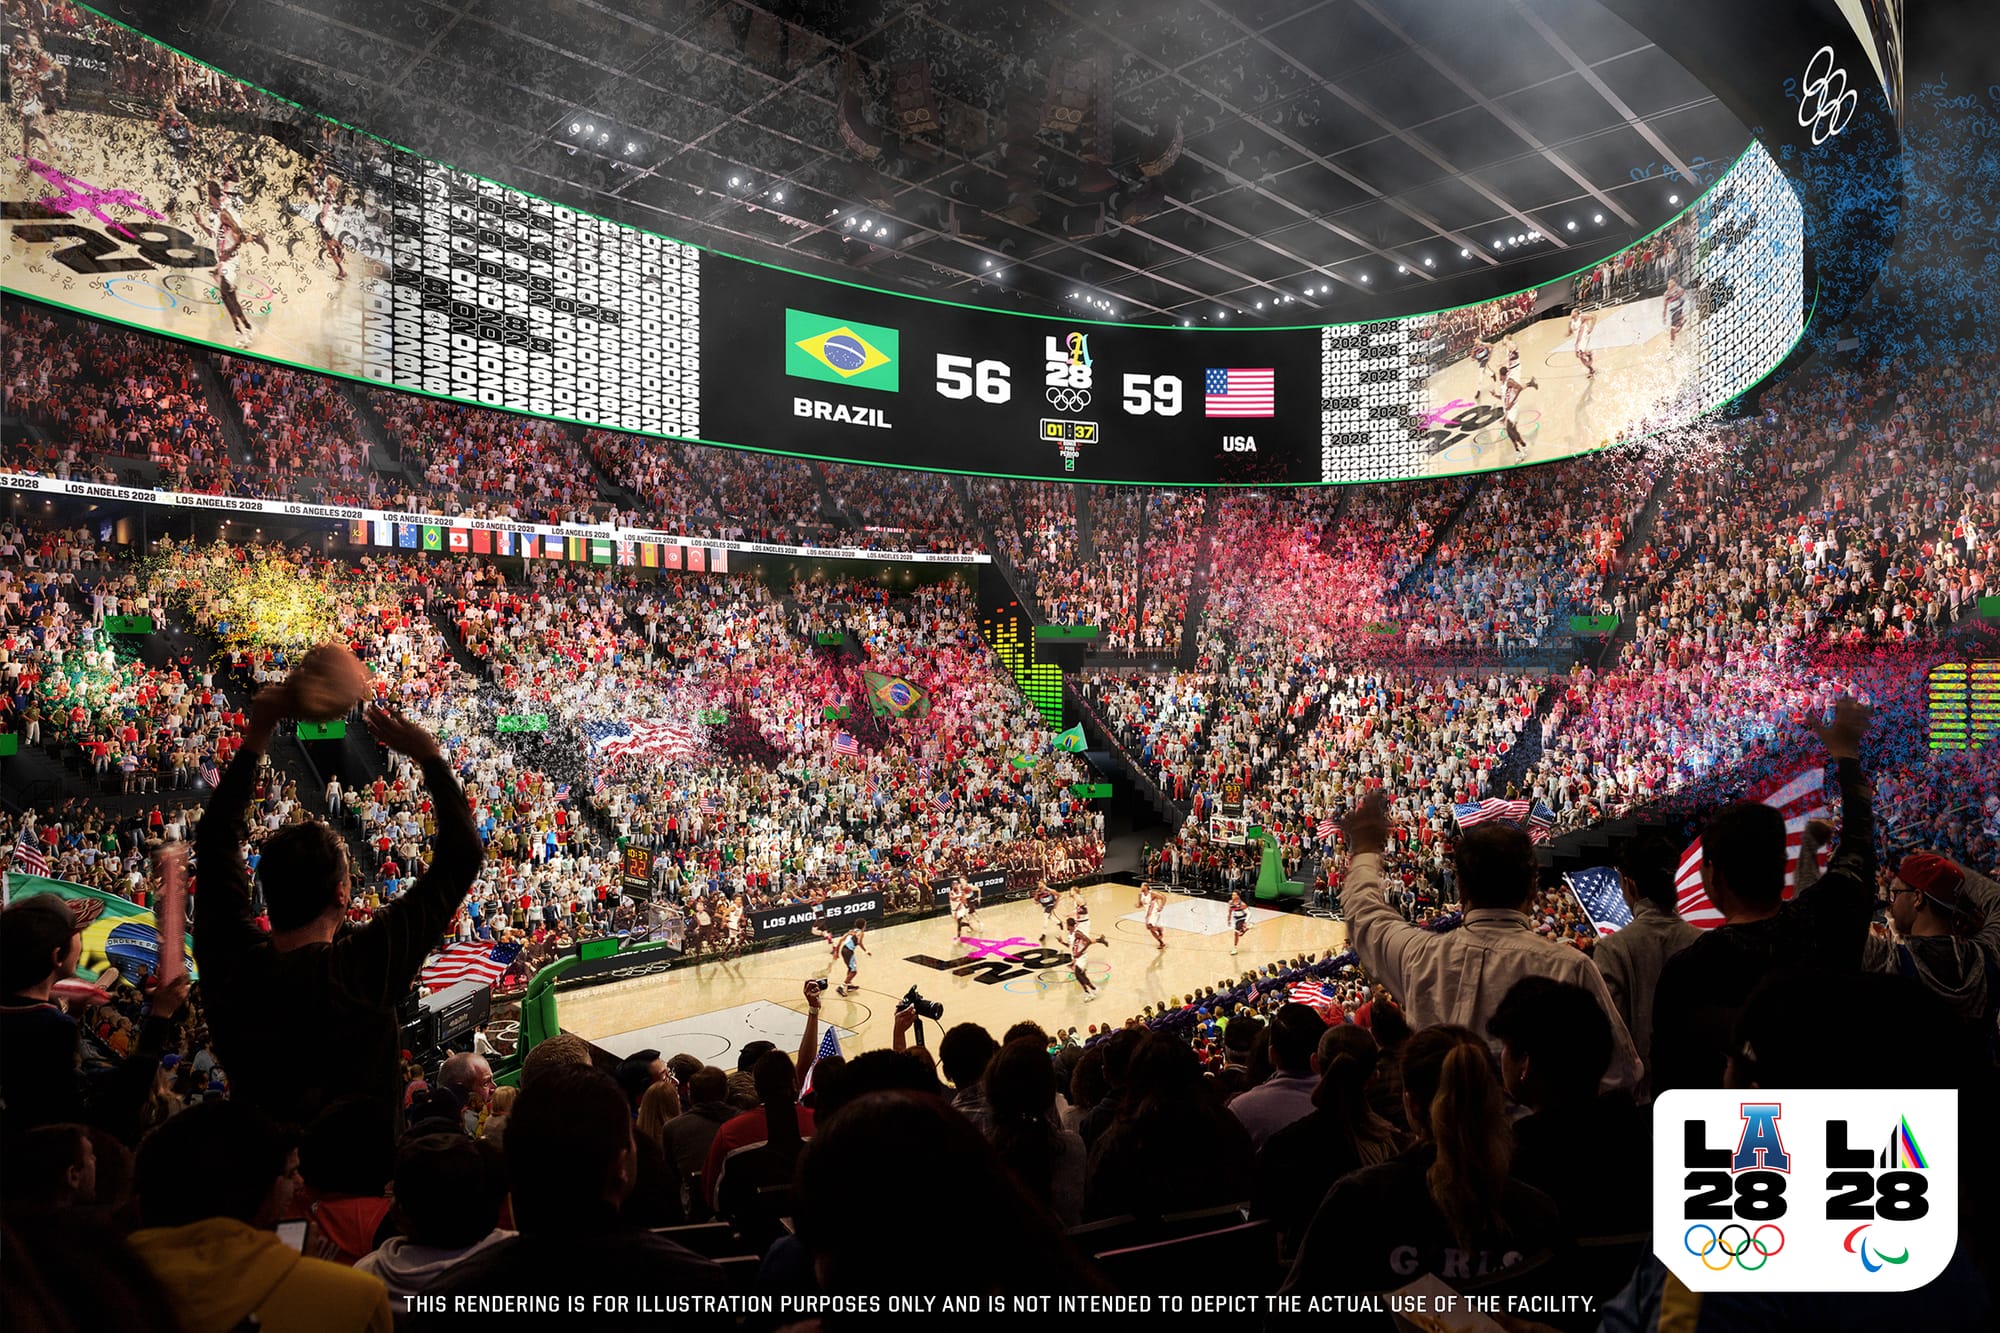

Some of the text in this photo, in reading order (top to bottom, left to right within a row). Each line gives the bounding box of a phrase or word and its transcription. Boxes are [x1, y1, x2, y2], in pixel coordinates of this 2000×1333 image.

[937, 354, 1010, 403] 56
[1046, 364, 1092, 388] 28
[1123, 374, 1182, 416] 59
[794, 398, 892, 428] BRAZIL
[1223, 436, 1256, 452] USA
[11, 478, 39, 488] 2028
[65, 484, 156, 501] LOS ANGELES 2028
[176, 496, 263, 510] LOS ANGELES 2028
[284, 505, 362, 519] LOS ANGELES 2028
[400, 515, 433, 524] ANGELES
[434, 518, 453, 526] 2028
[486, 523, 516, 532] ANGELES
[518, 524, 535, 532] 2028
[565, 529, 593, 537] ANGELES
[636, 535, 662, 544] ANGELES
[630, 859, 645, 877] 22
[985, 877, 1004, 886] 2028
[763, 900, 876, 929] LOS ANGES 2028
